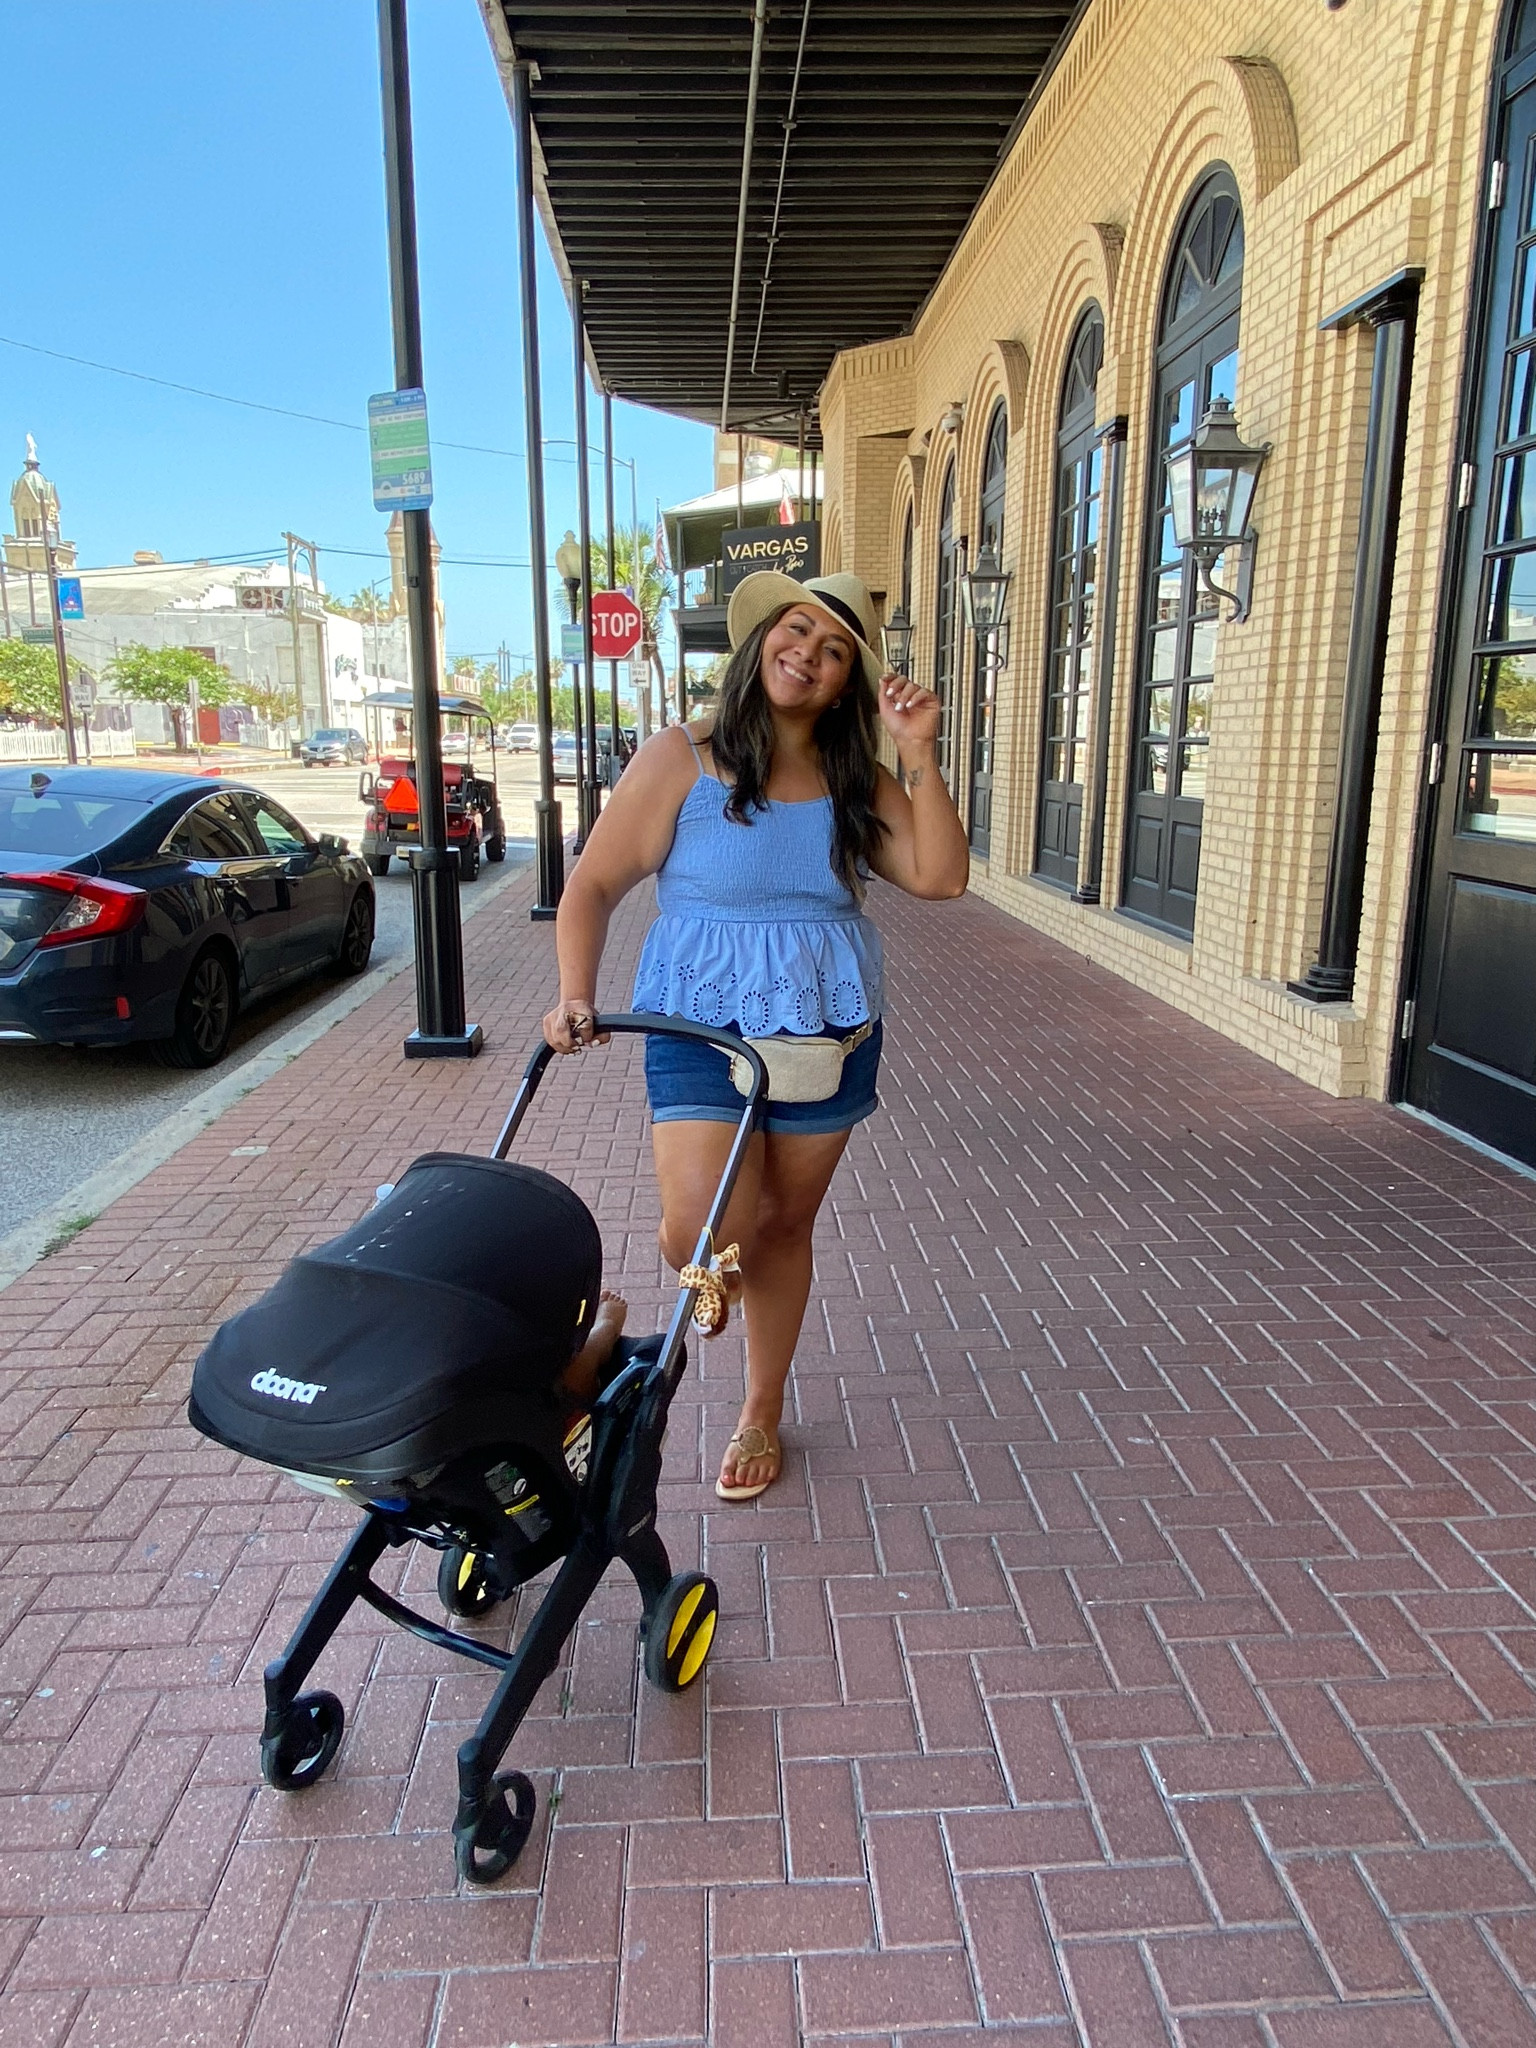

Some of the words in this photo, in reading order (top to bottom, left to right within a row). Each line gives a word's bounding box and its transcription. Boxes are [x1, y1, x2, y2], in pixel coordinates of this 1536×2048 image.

[402, 472, 425, 485] 5689
[727, 536, 809, 560] VARGAS
[250, 1367, 318, 1405] doona
